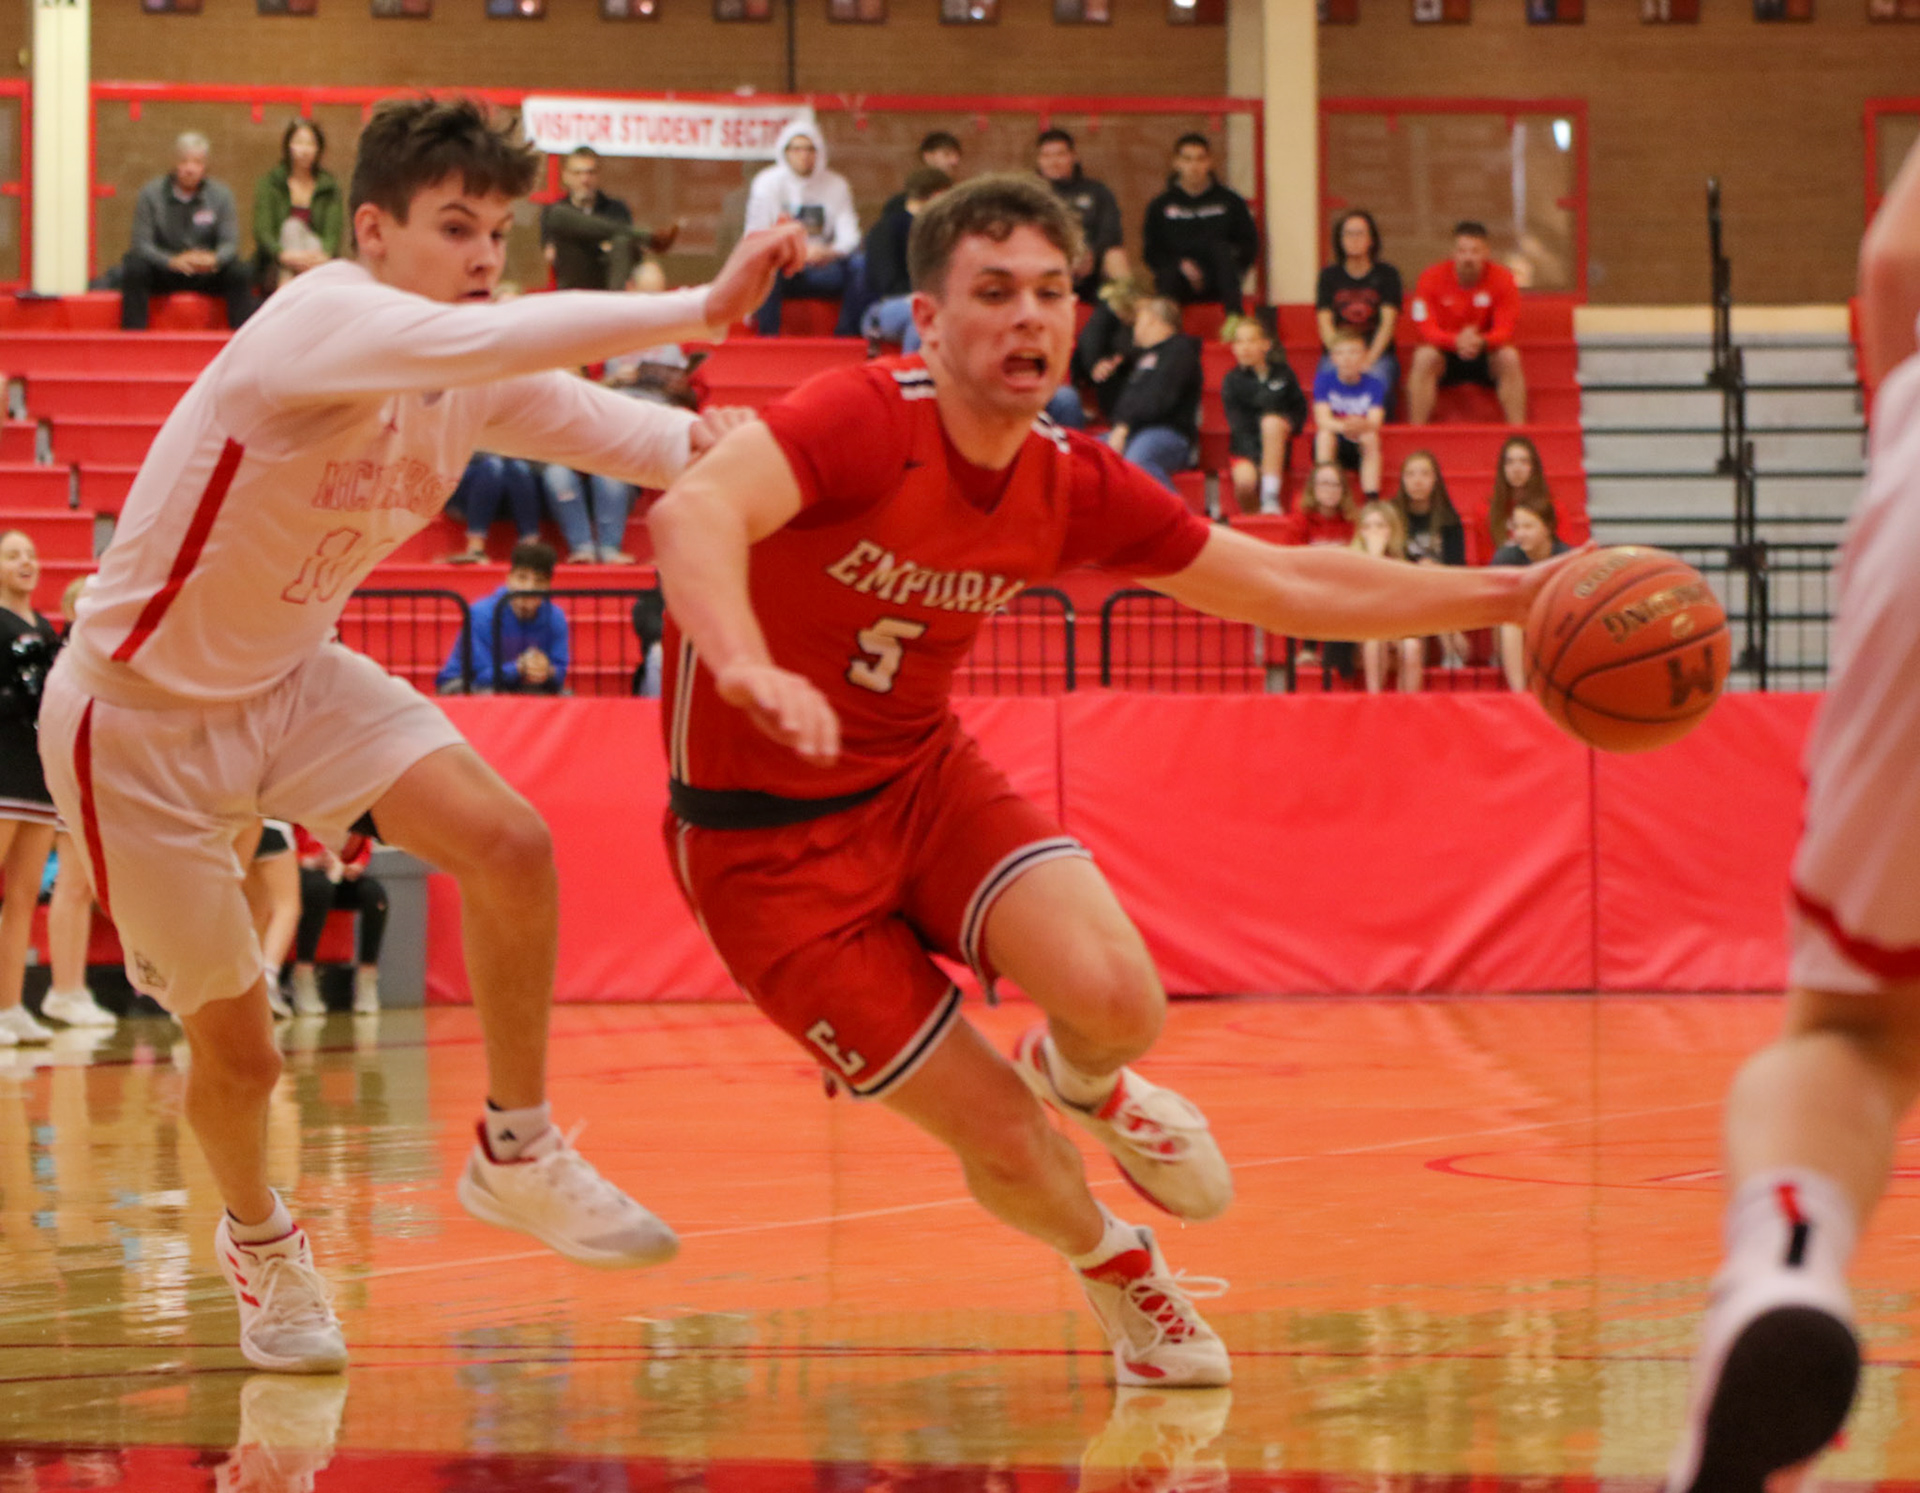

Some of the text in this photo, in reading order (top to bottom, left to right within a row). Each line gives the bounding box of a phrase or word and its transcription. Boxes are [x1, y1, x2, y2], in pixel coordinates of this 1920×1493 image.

[532, 112, 612, 142] VISITOR
[620, 114, 713, 147] STUDENT
[846, 616, 927, 693] 5
[805, 1019, 866, 1077] E
